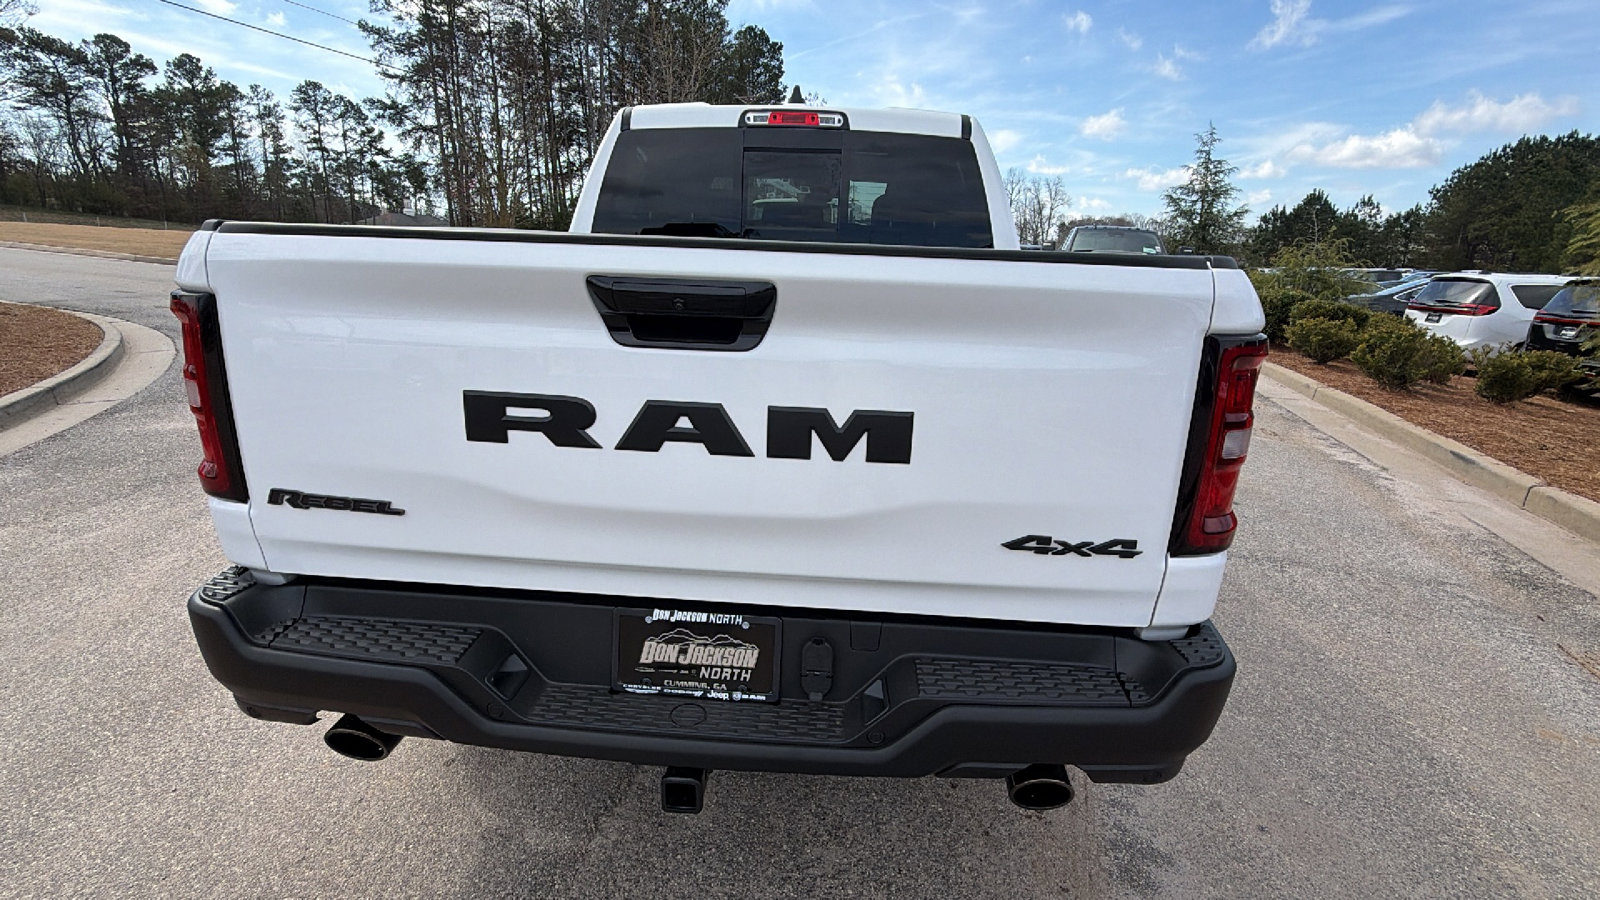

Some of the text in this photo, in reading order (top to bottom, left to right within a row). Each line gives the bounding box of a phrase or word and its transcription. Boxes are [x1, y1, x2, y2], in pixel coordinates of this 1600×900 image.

[463, 390, 915, 464] RAM
[267, 488, 405, 516] REBEL
[1000, 534, 1143, 558] 4x4
[708, 613, 743, 625] NORTH
[639, 641, 760, 669] DON JACKSON
[699, 666, 752, 682] NORTH
[706, 689, 730, 701] Jeep
[712, 683, 727, 691] GA
